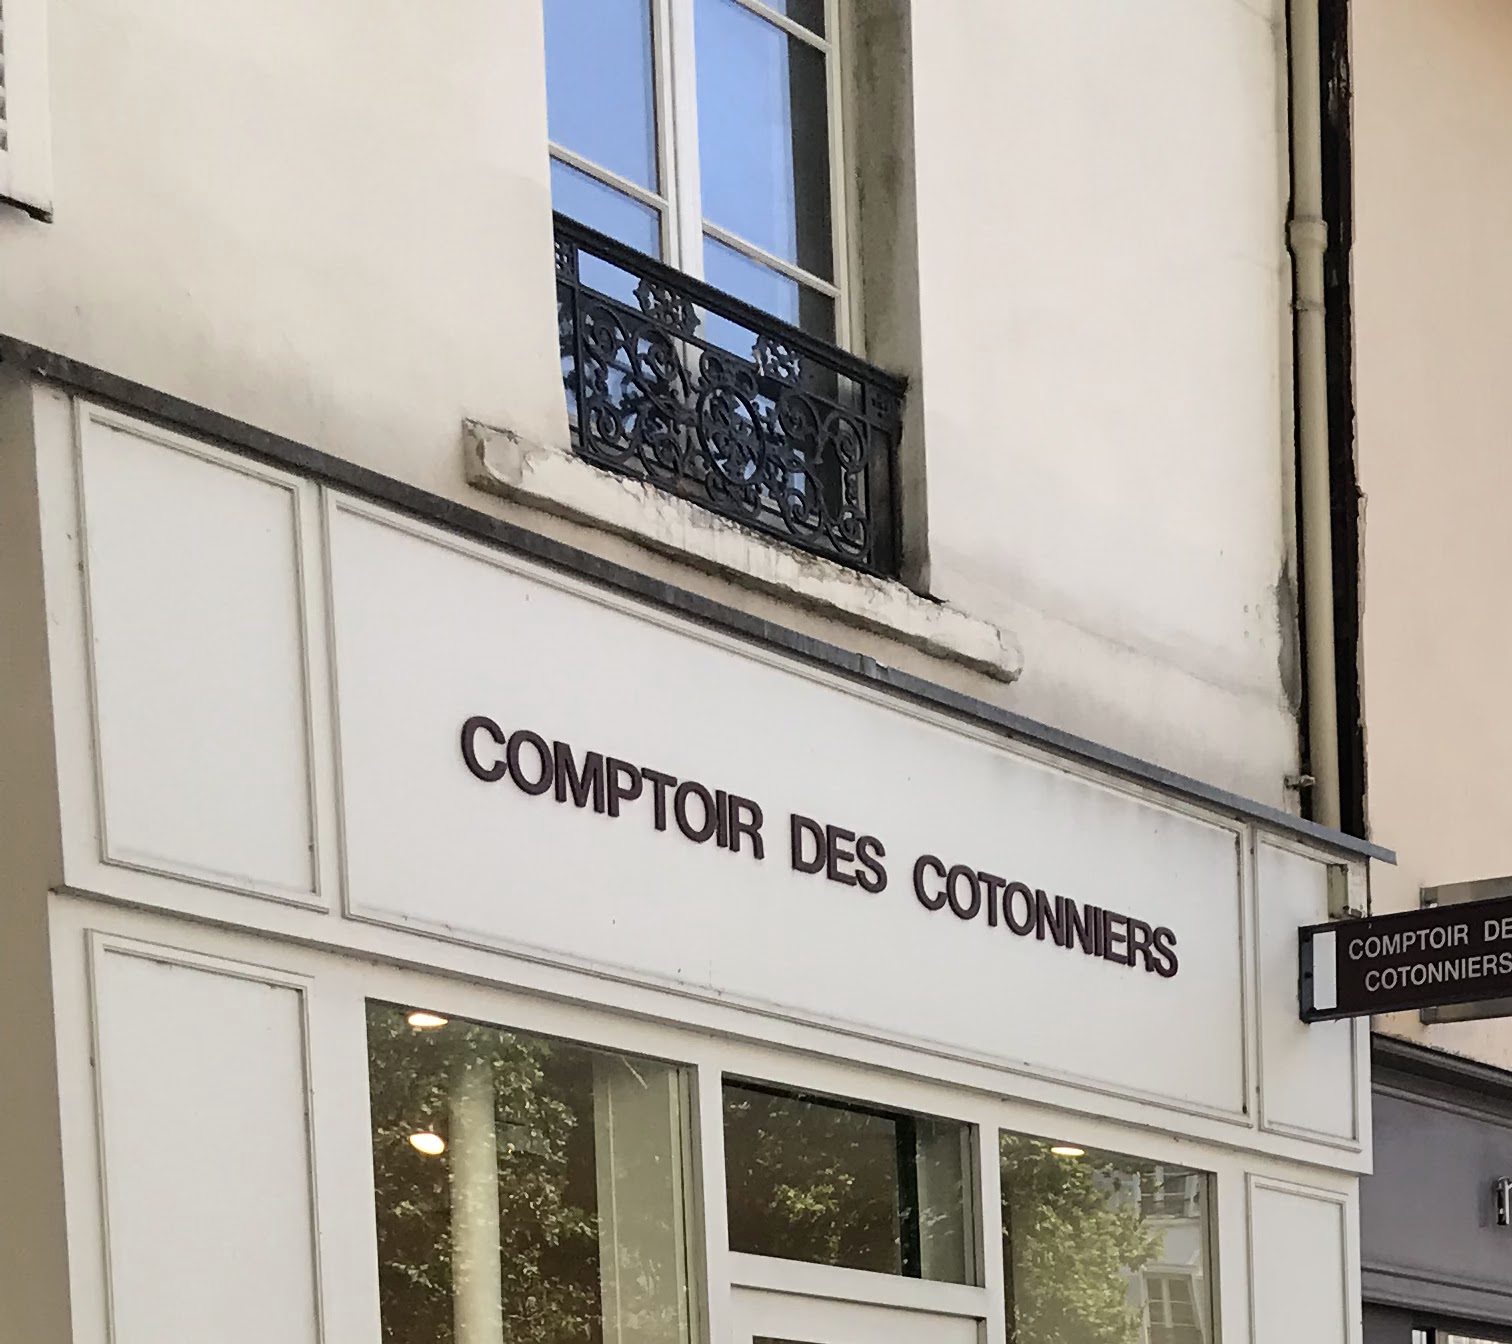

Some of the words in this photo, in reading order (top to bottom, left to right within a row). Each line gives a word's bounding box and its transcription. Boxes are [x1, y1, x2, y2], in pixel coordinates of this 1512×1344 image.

[461, 715, 765, 861] COMPTOIR
[790, 813, 888, 894] DES
[912, 853, 1179, 978] COTONNIERS
[1348, 923, 1469, 960] COMPTOIR
[1365, 952, 1512, 992] COTONNIERS
